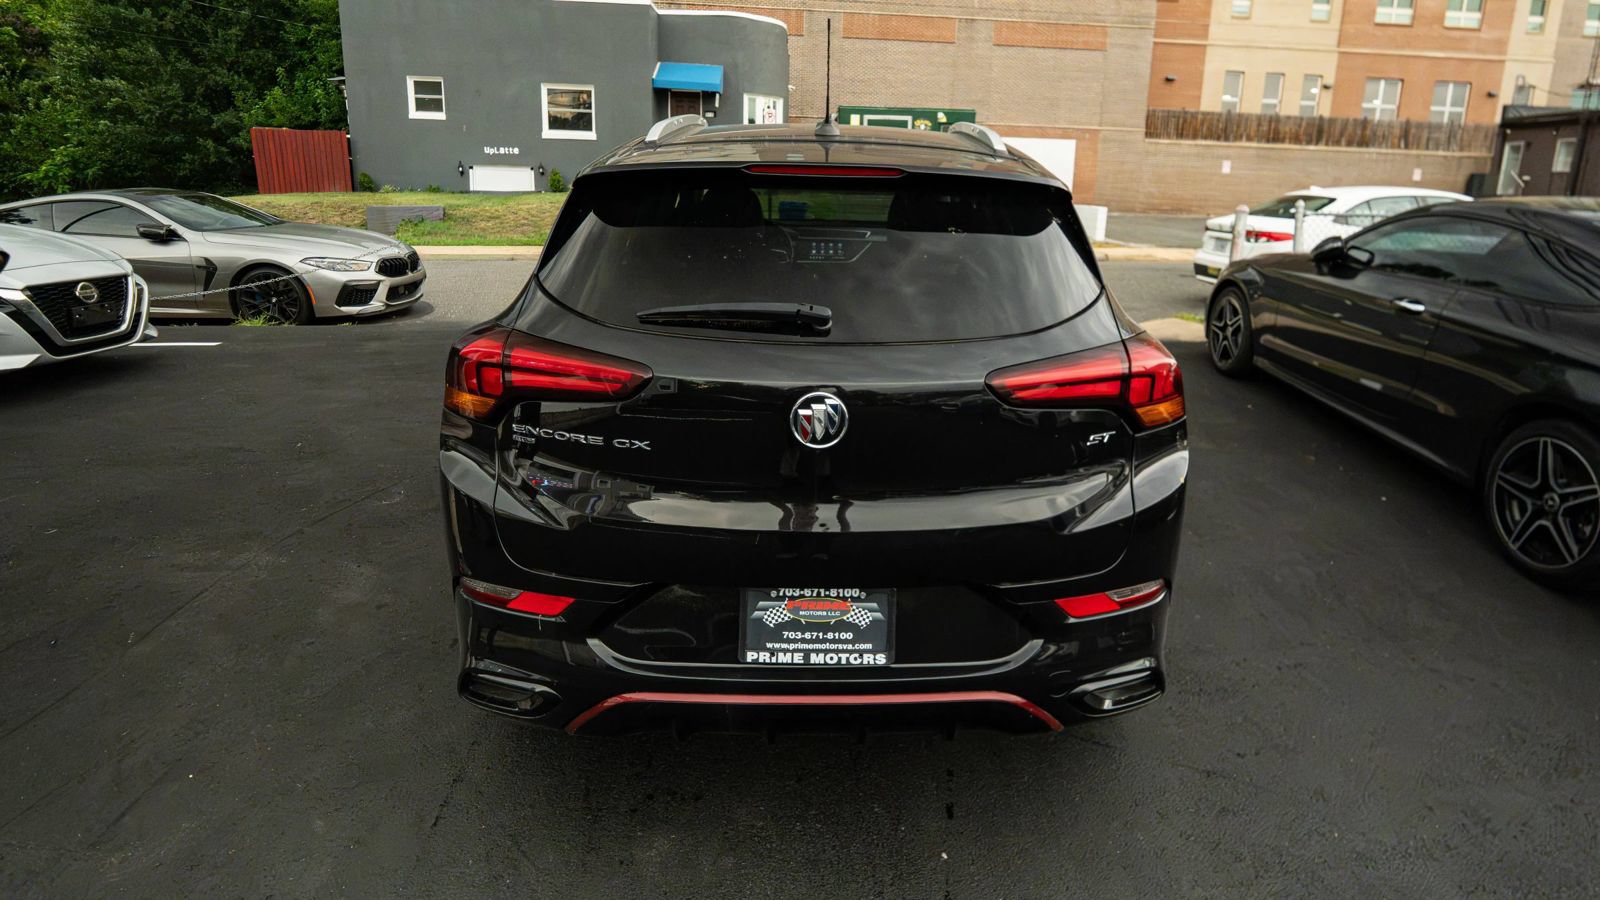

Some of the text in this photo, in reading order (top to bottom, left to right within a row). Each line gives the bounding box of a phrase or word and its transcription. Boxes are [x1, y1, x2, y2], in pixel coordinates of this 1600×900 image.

[484, 146, 519, 155] UpLatte
[512, 424, 604, 445] ENCORE
[613, 439, 651, 450] GX
[1087, 431, 1116, 446] ST
[778, 588, 860, 597] 703-671-8100
[783, 631, 853, 640] 703-671-8100
[766, 642, 872, 650] www.primemotorsva.com
[746, 652, 804, 663] PRIME
[810, 653, 886, 665] MOTORS
